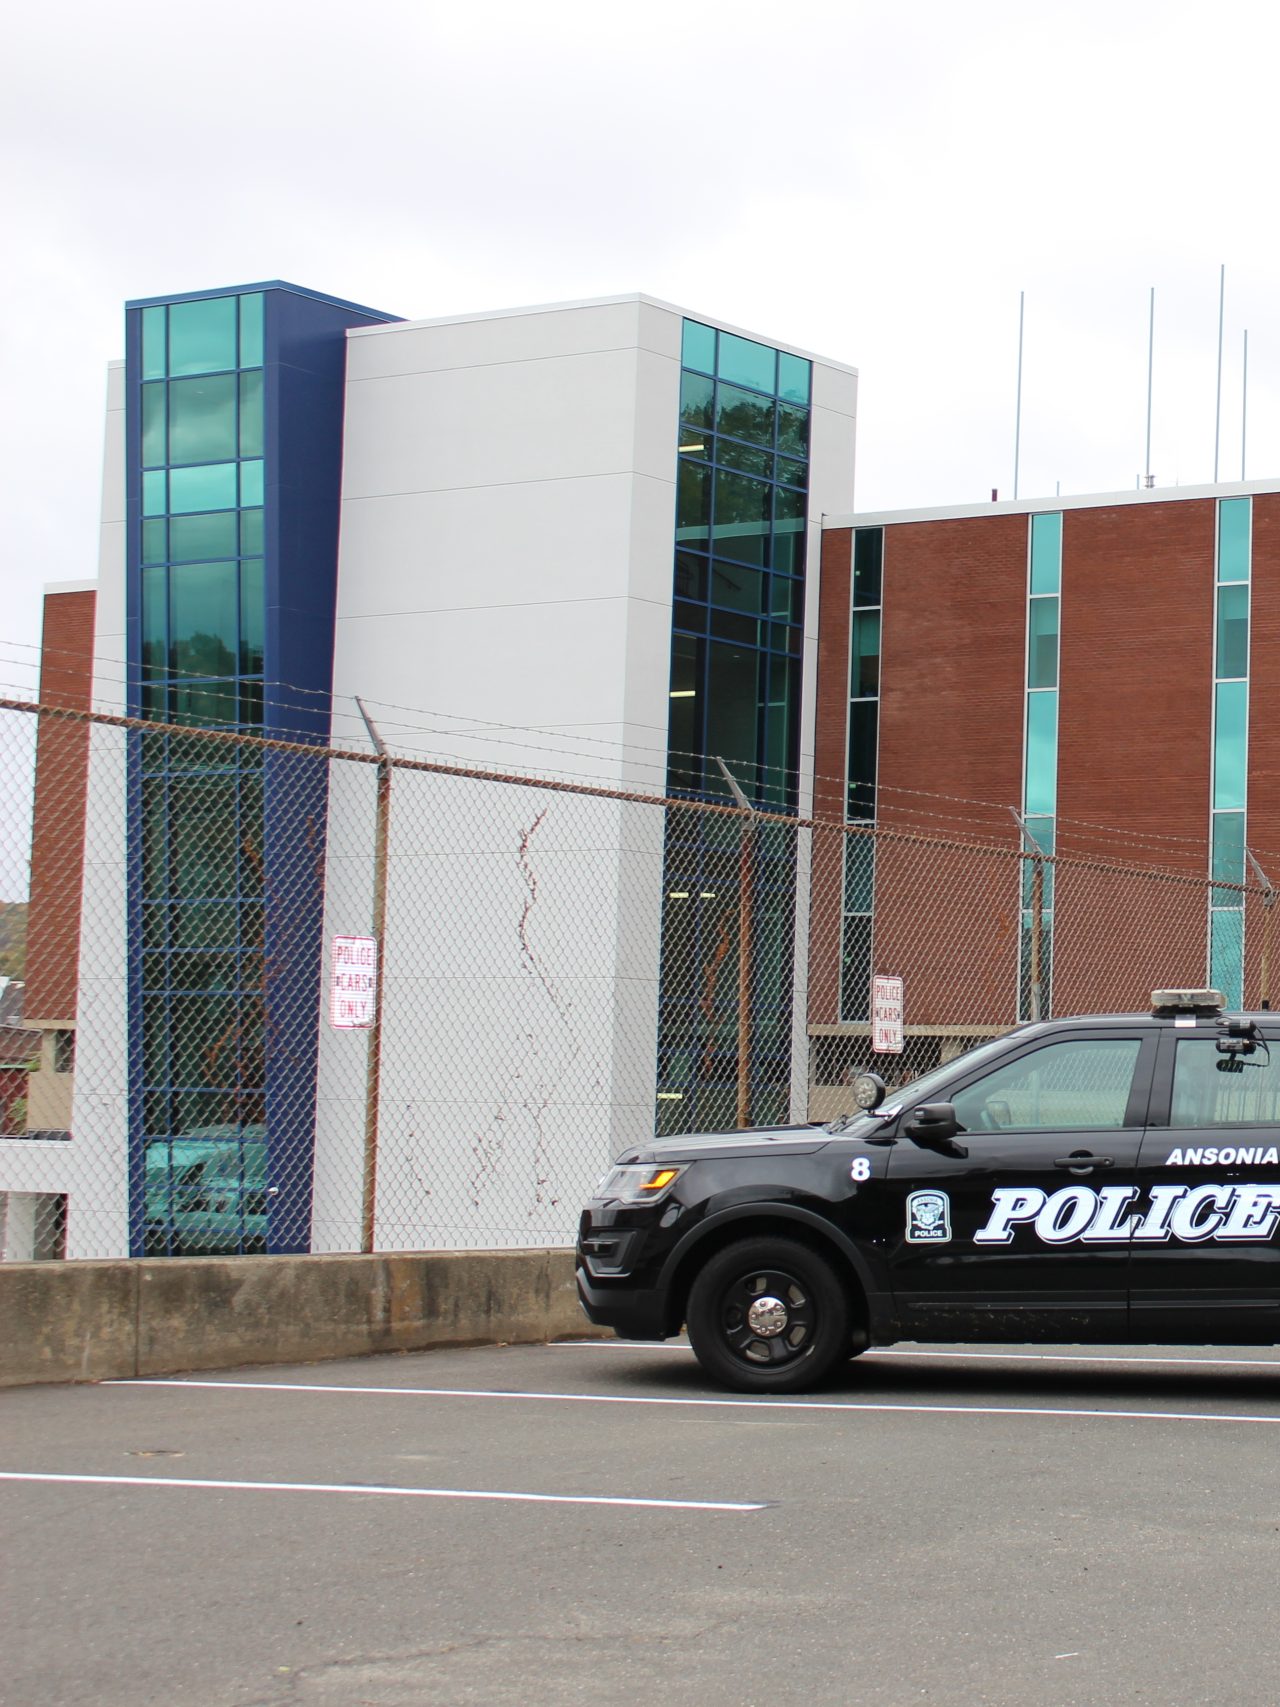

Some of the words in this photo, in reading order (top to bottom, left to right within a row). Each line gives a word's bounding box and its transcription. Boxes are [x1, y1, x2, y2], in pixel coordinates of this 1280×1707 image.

[337, 946, 373, 966] POLICE
[341, 973, 368, 992] CARS
[876, 985, 900, 1001] POLICE
[340, 1000, 367, 1018] ONLY
[879, 1007, 897, 1022] CARS
[879, 1028, 897, 1044] ONLY
[1165, 1147, 1279, 1166] ANSONIA
[850, 1157, 871, 1182] 8
[914, 1230, 943, 1238] POLICE
